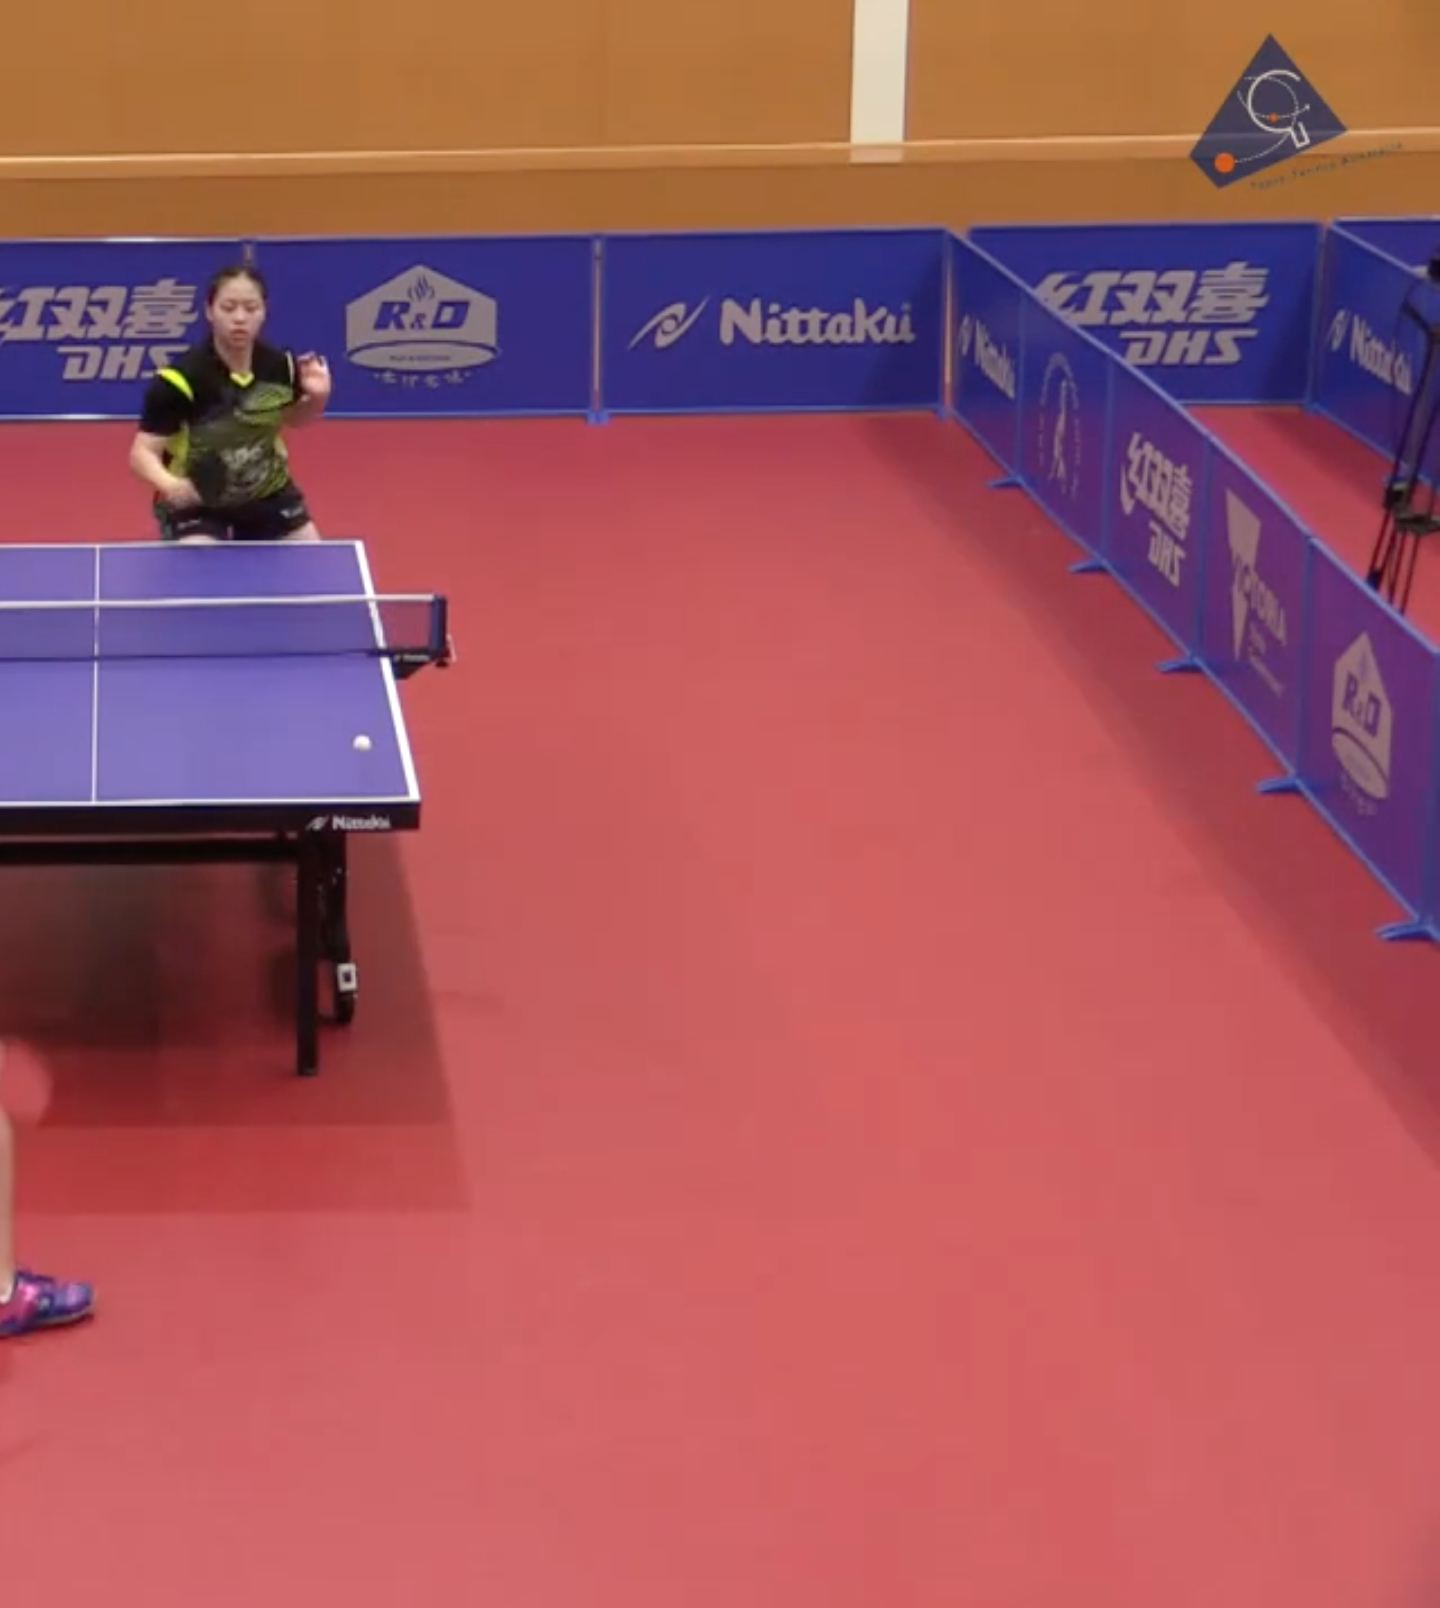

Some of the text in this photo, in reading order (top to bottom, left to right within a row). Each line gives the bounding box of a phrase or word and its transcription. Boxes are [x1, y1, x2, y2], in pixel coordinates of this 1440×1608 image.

[373, 301, 470, 330] R&D
[719, 297, 916, 345] Nittaku
[1119, 328, 1259, 367] DHS
